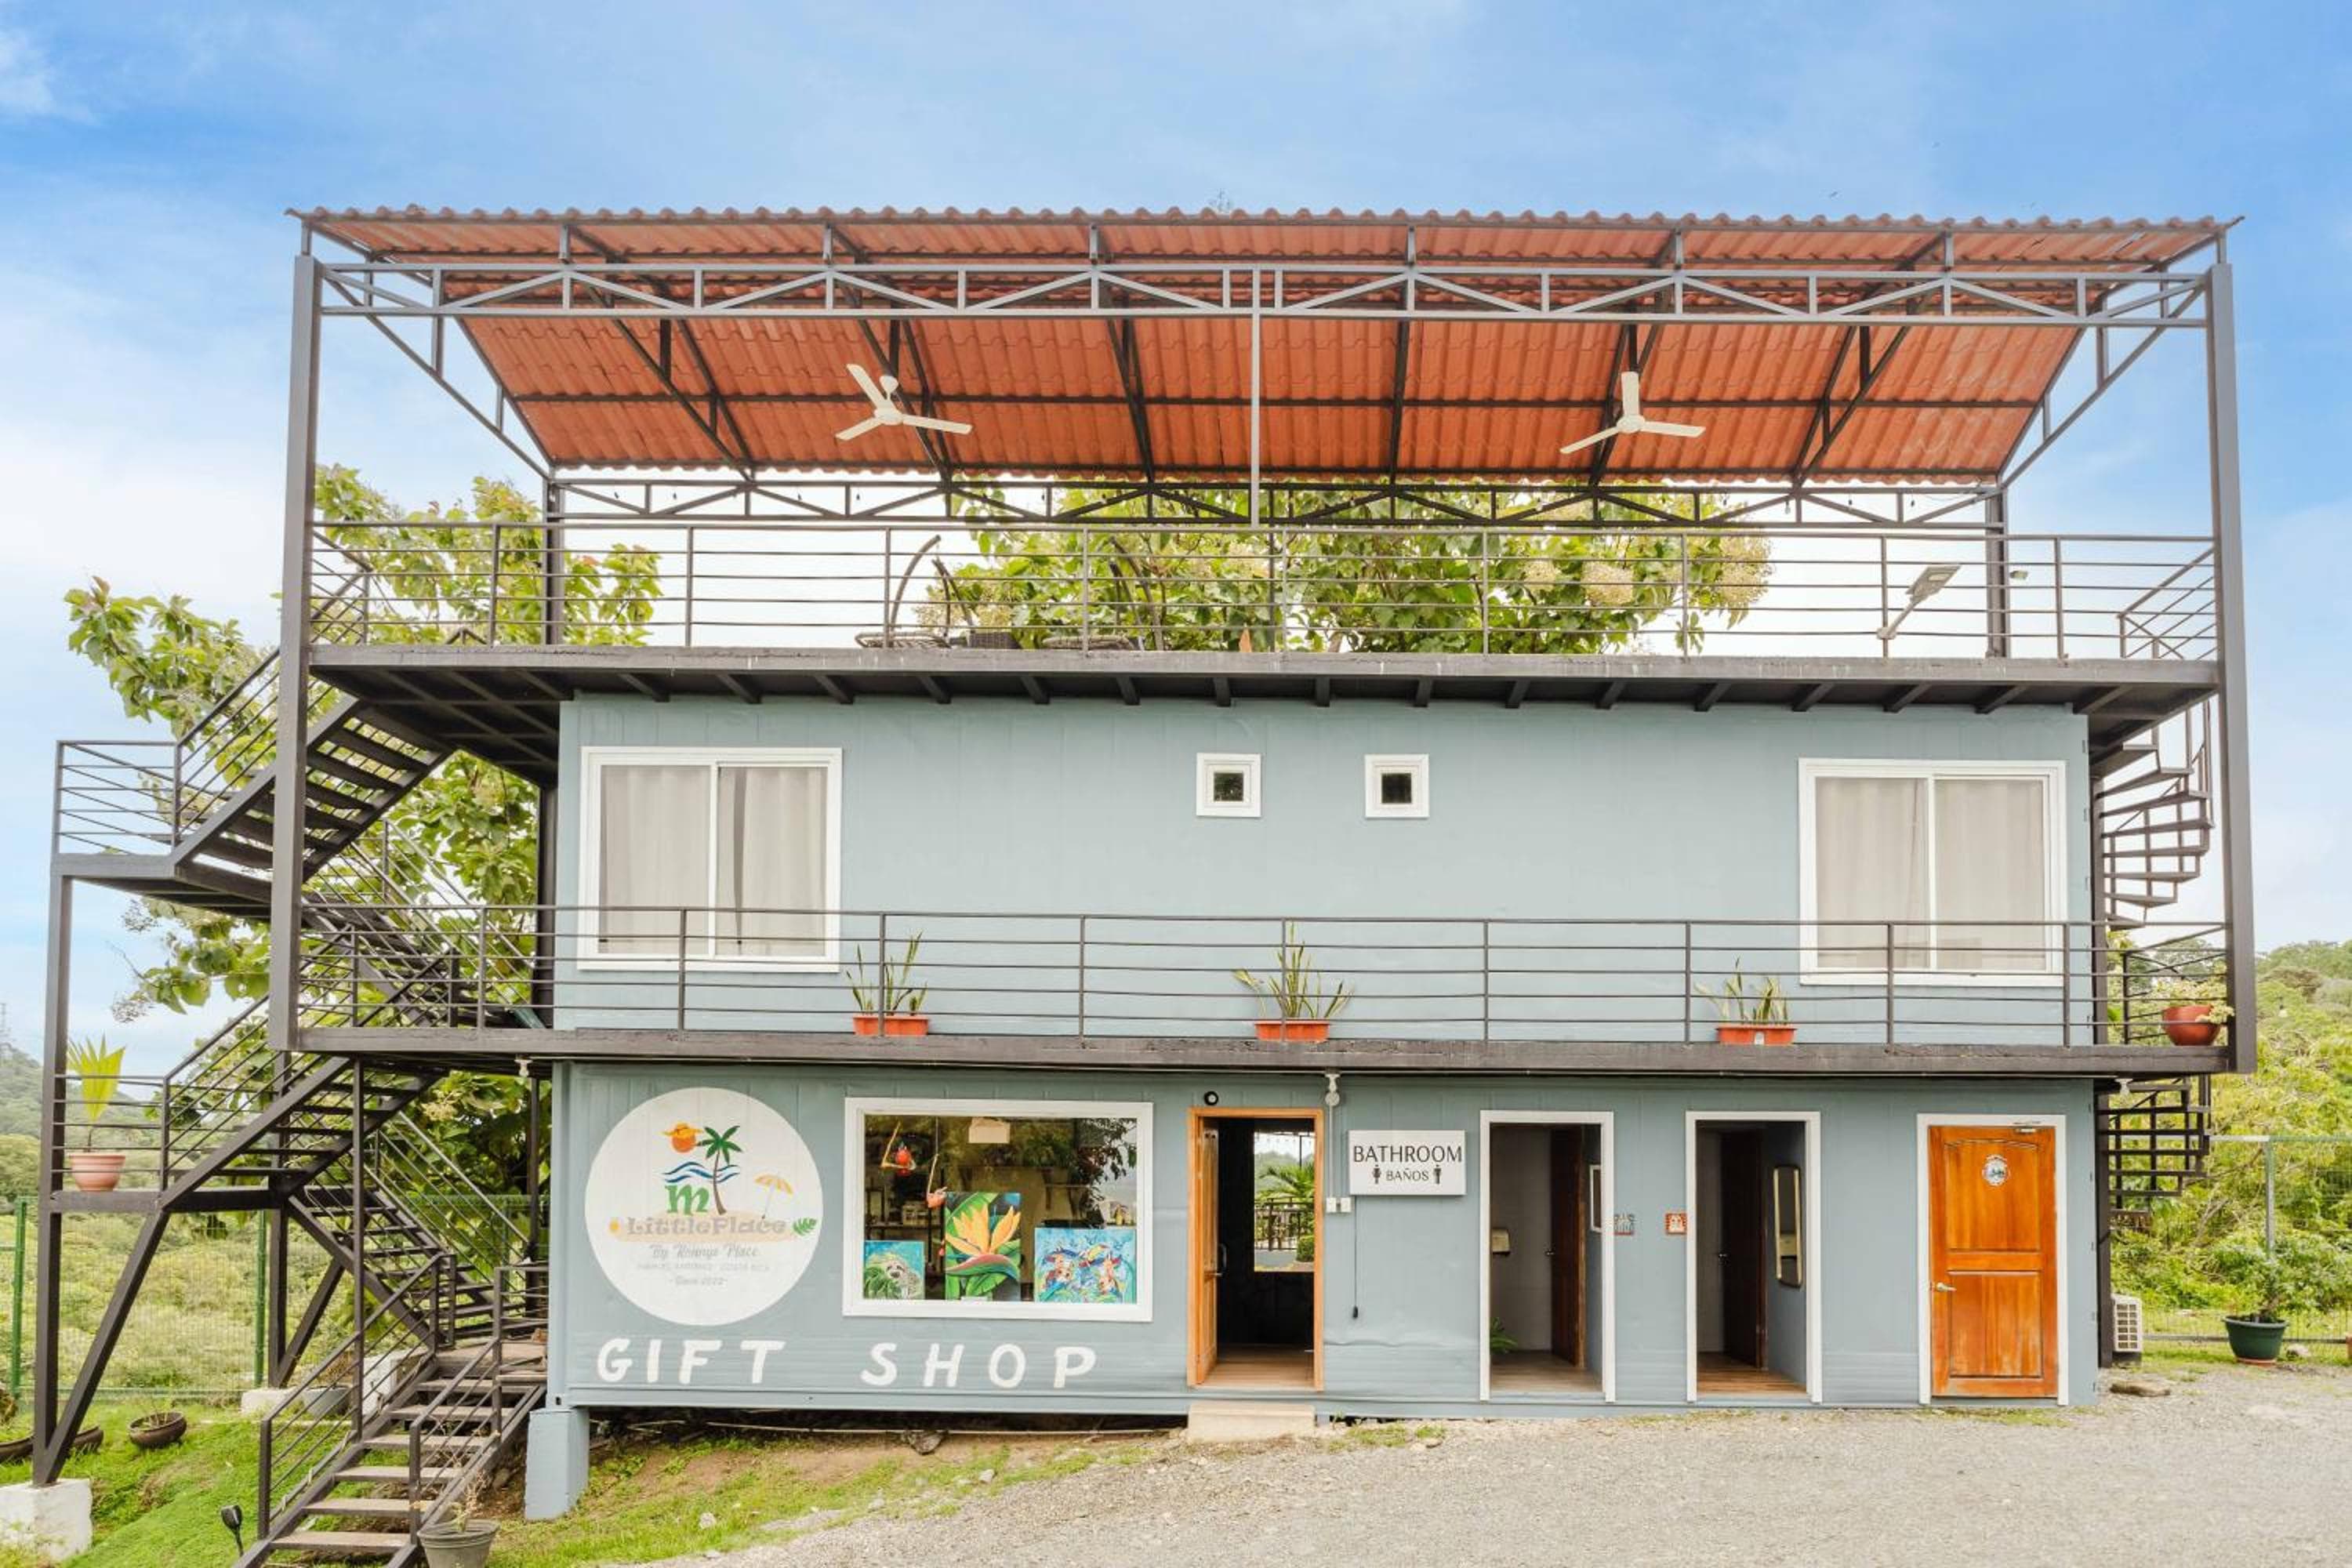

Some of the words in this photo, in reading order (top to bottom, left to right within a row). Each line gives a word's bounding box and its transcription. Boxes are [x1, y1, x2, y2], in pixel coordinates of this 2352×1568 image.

[1353, 1145, 1463, 1163] BATHROOM
[1385, 1167, 1430, 1182] BAÑOS
[626, 1216, 786, 1236] LittlePlace
[596, 1338, 786, 1385] GIFT
[859, 1341, 1097, 1389] SHOP
